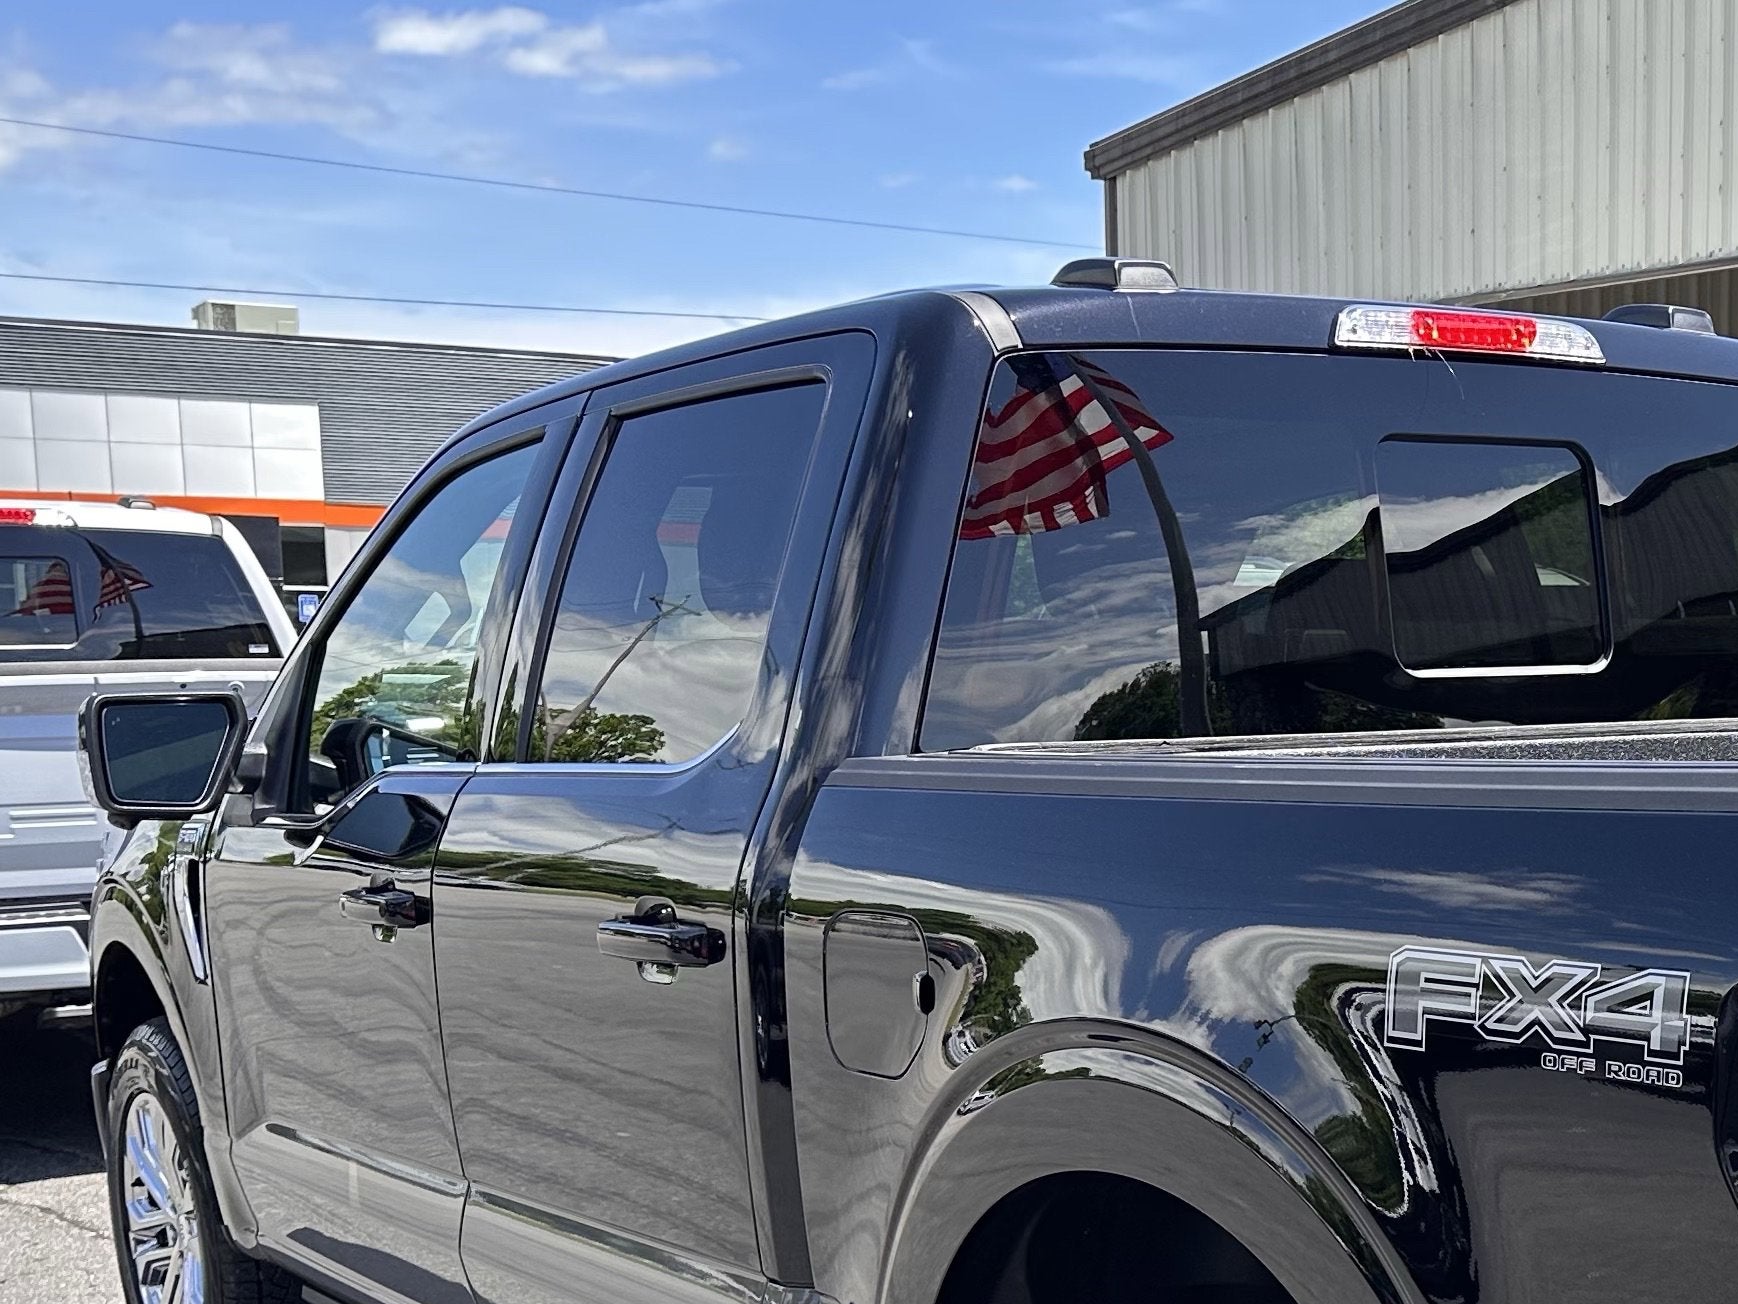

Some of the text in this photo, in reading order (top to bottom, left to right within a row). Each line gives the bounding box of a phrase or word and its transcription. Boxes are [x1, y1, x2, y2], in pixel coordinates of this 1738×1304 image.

[1384, 945, 1691, 1066] FX4
[1540, 1052, 1683, 1088] OFF ROAD
